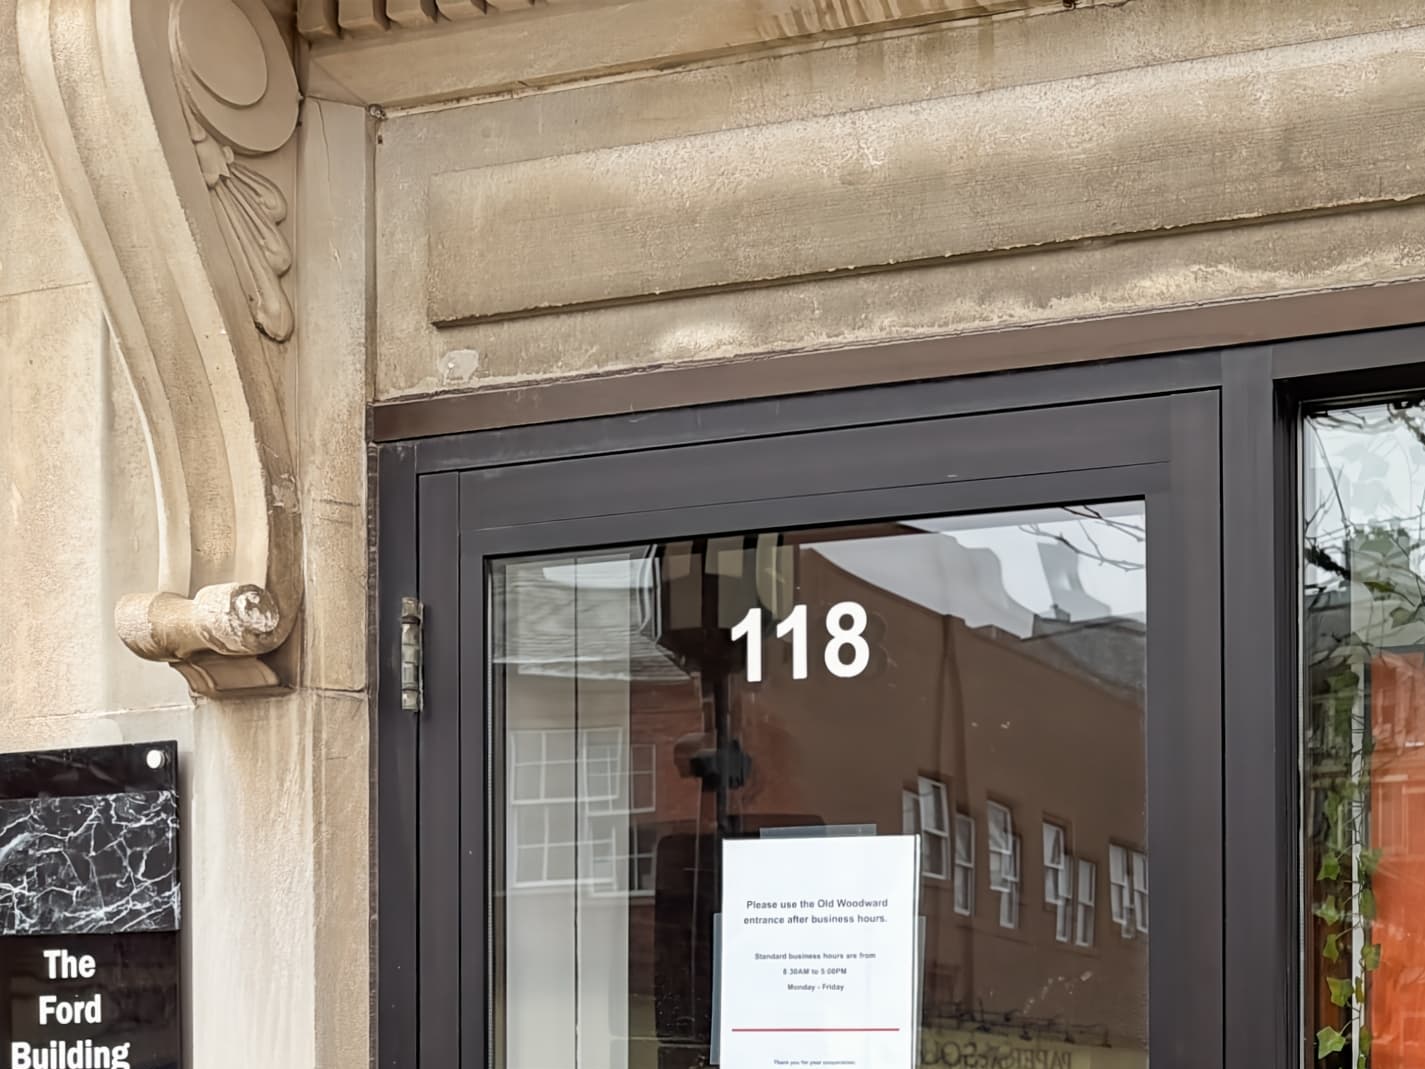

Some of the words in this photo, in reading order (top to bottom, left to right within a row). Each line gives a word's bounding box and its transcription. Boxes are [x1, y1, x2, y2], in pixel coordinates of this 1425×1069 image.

[731, 601, 870, 682] 118
[746, 900, 778, 910] Please
[780, 901, 798, 909] use
[800, 899, 815, 909] the
[817, 898, 835, 909] Old
[836, 898, 888, 908] Woodward
[743, 915, 785, 925] entrance
[787, 914, 809, 924] after
[811, 914, 855, 924] business
[857, 913, 888, 923] hours.
[754, 952, 787, 961] Standard
[788, 952, 821, 960] business
[823, 952, 844, 960] hours
[859, 951, 876, 960] from
[43, 949, 97, 979] The
[782, 967, 810, 976] 830AM
[811, 967, 819, 976] to
[820, 967, 847, 976] 500PM
[787, 983, 816, 993] Monday
[821, 983, 845, 992] Friday
[39, 994, 102, 1025] Ford
